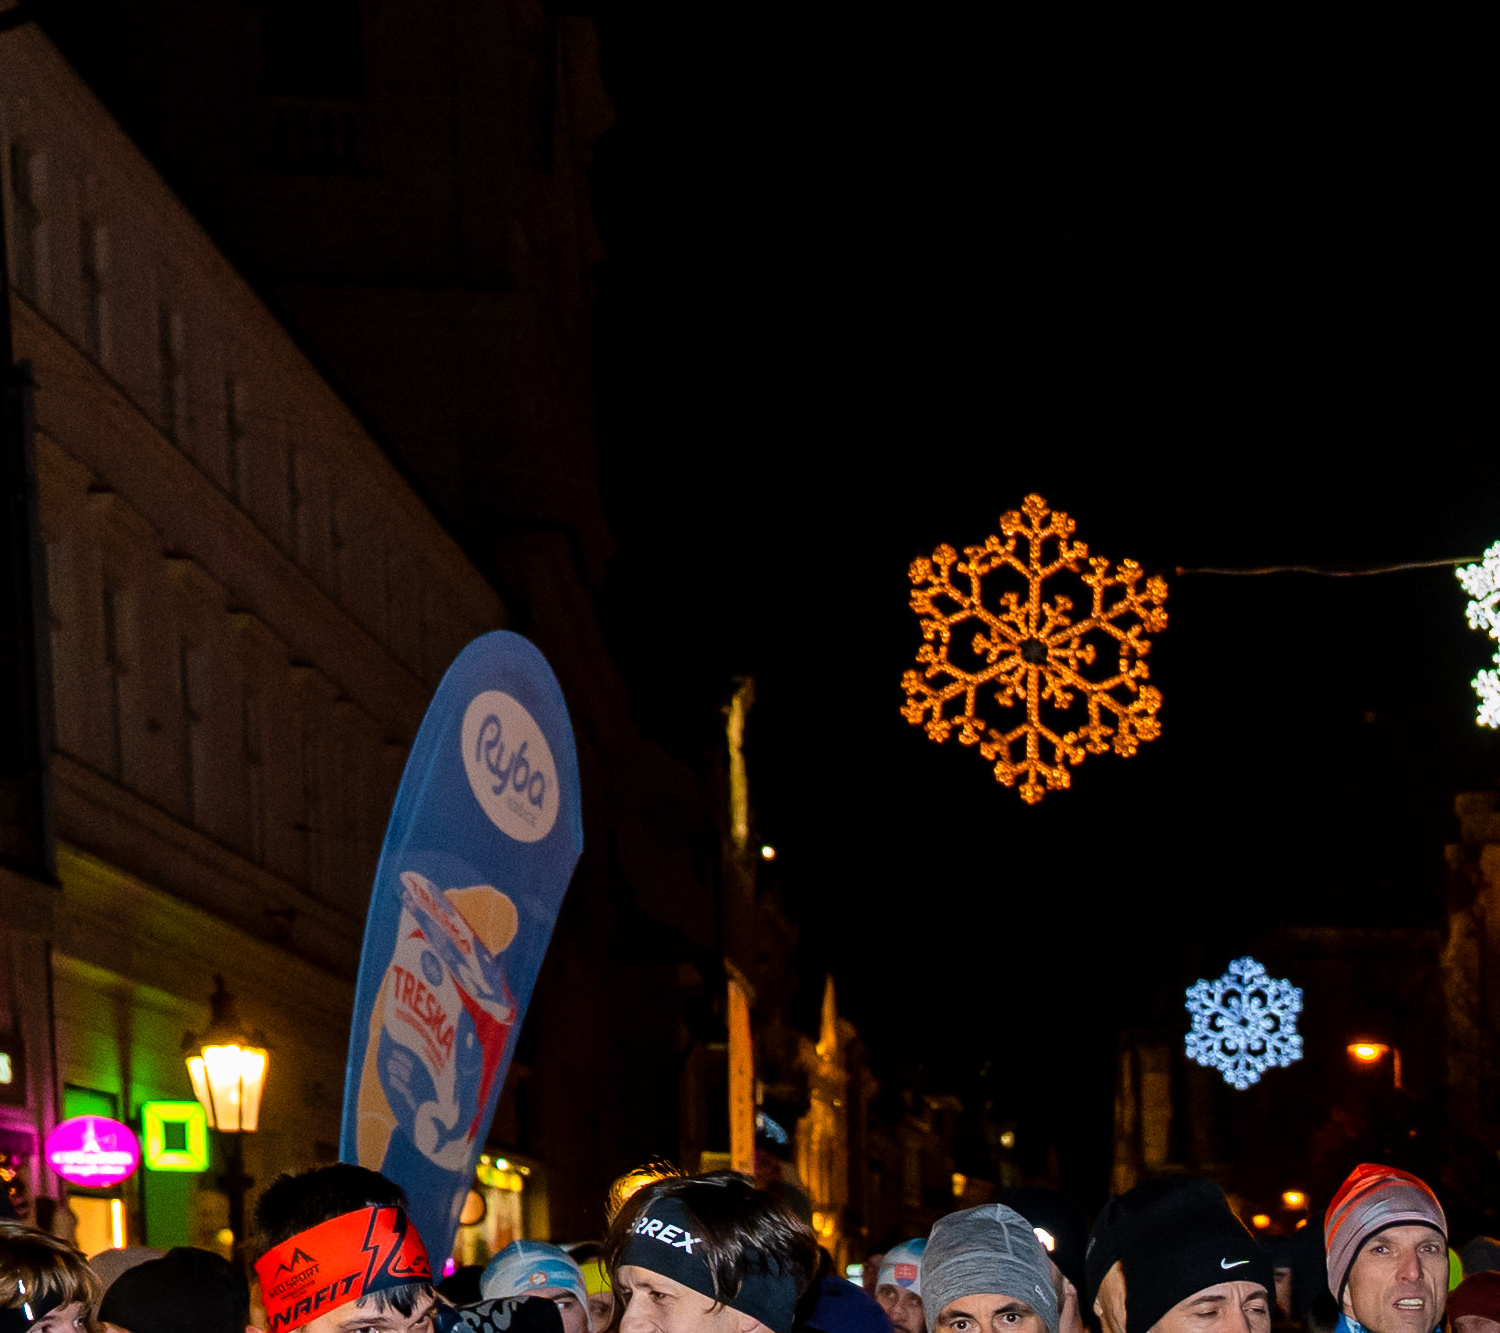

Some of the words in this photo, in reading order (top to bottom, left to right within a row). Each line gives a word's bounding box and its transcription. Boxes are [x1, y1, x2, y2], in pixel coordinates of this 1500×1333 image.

[475, 713, 545, 809] Ryba
[393, 965, 455, 1060] TRESKA
[287, 1264, 320, 1292] SPORT
